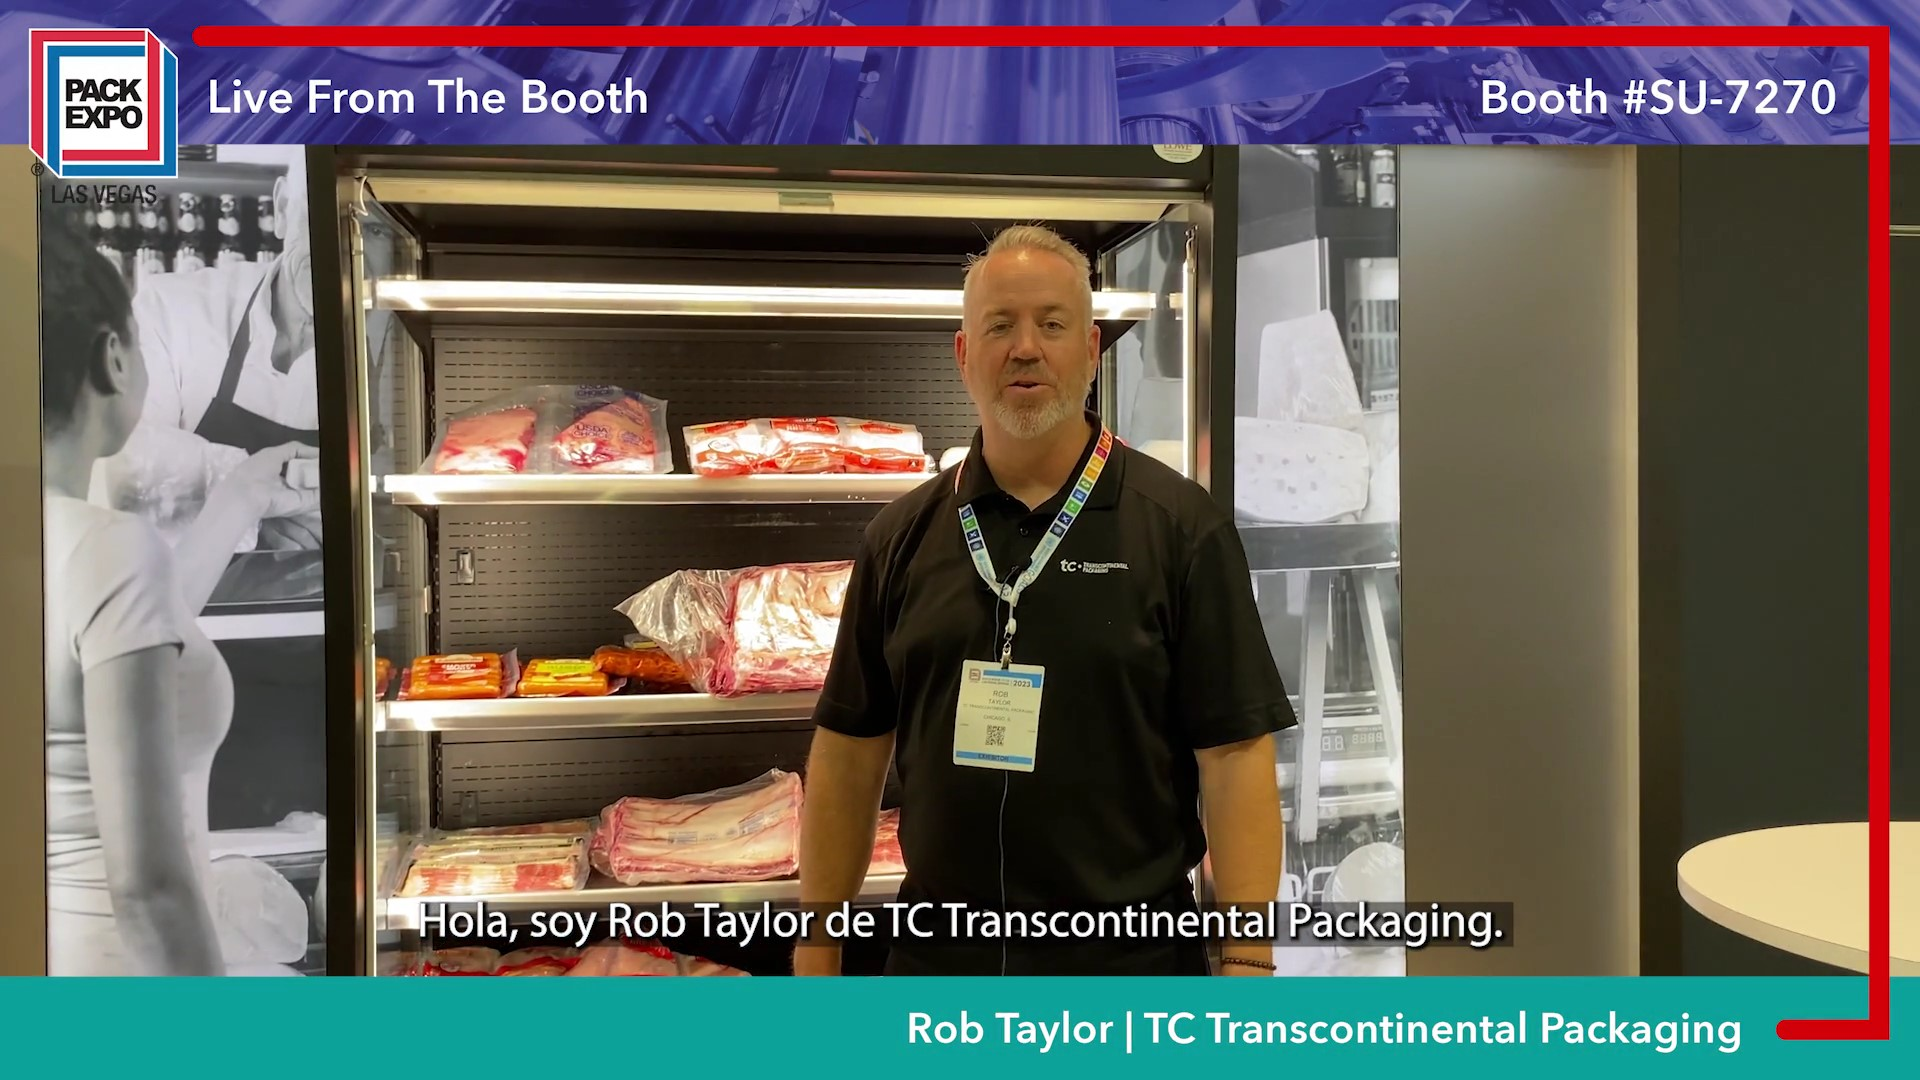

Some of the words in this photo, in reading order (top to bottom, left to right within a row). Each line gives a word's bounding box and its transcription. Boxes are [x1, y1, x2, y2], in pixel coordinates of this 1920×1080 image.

[575, 422, 608, 433] USDA
[1013, 679, 1031, 688] 2023
[992, 690, 1009, 698] ROB
[988, 698, 1011, 706] TAYLOR
